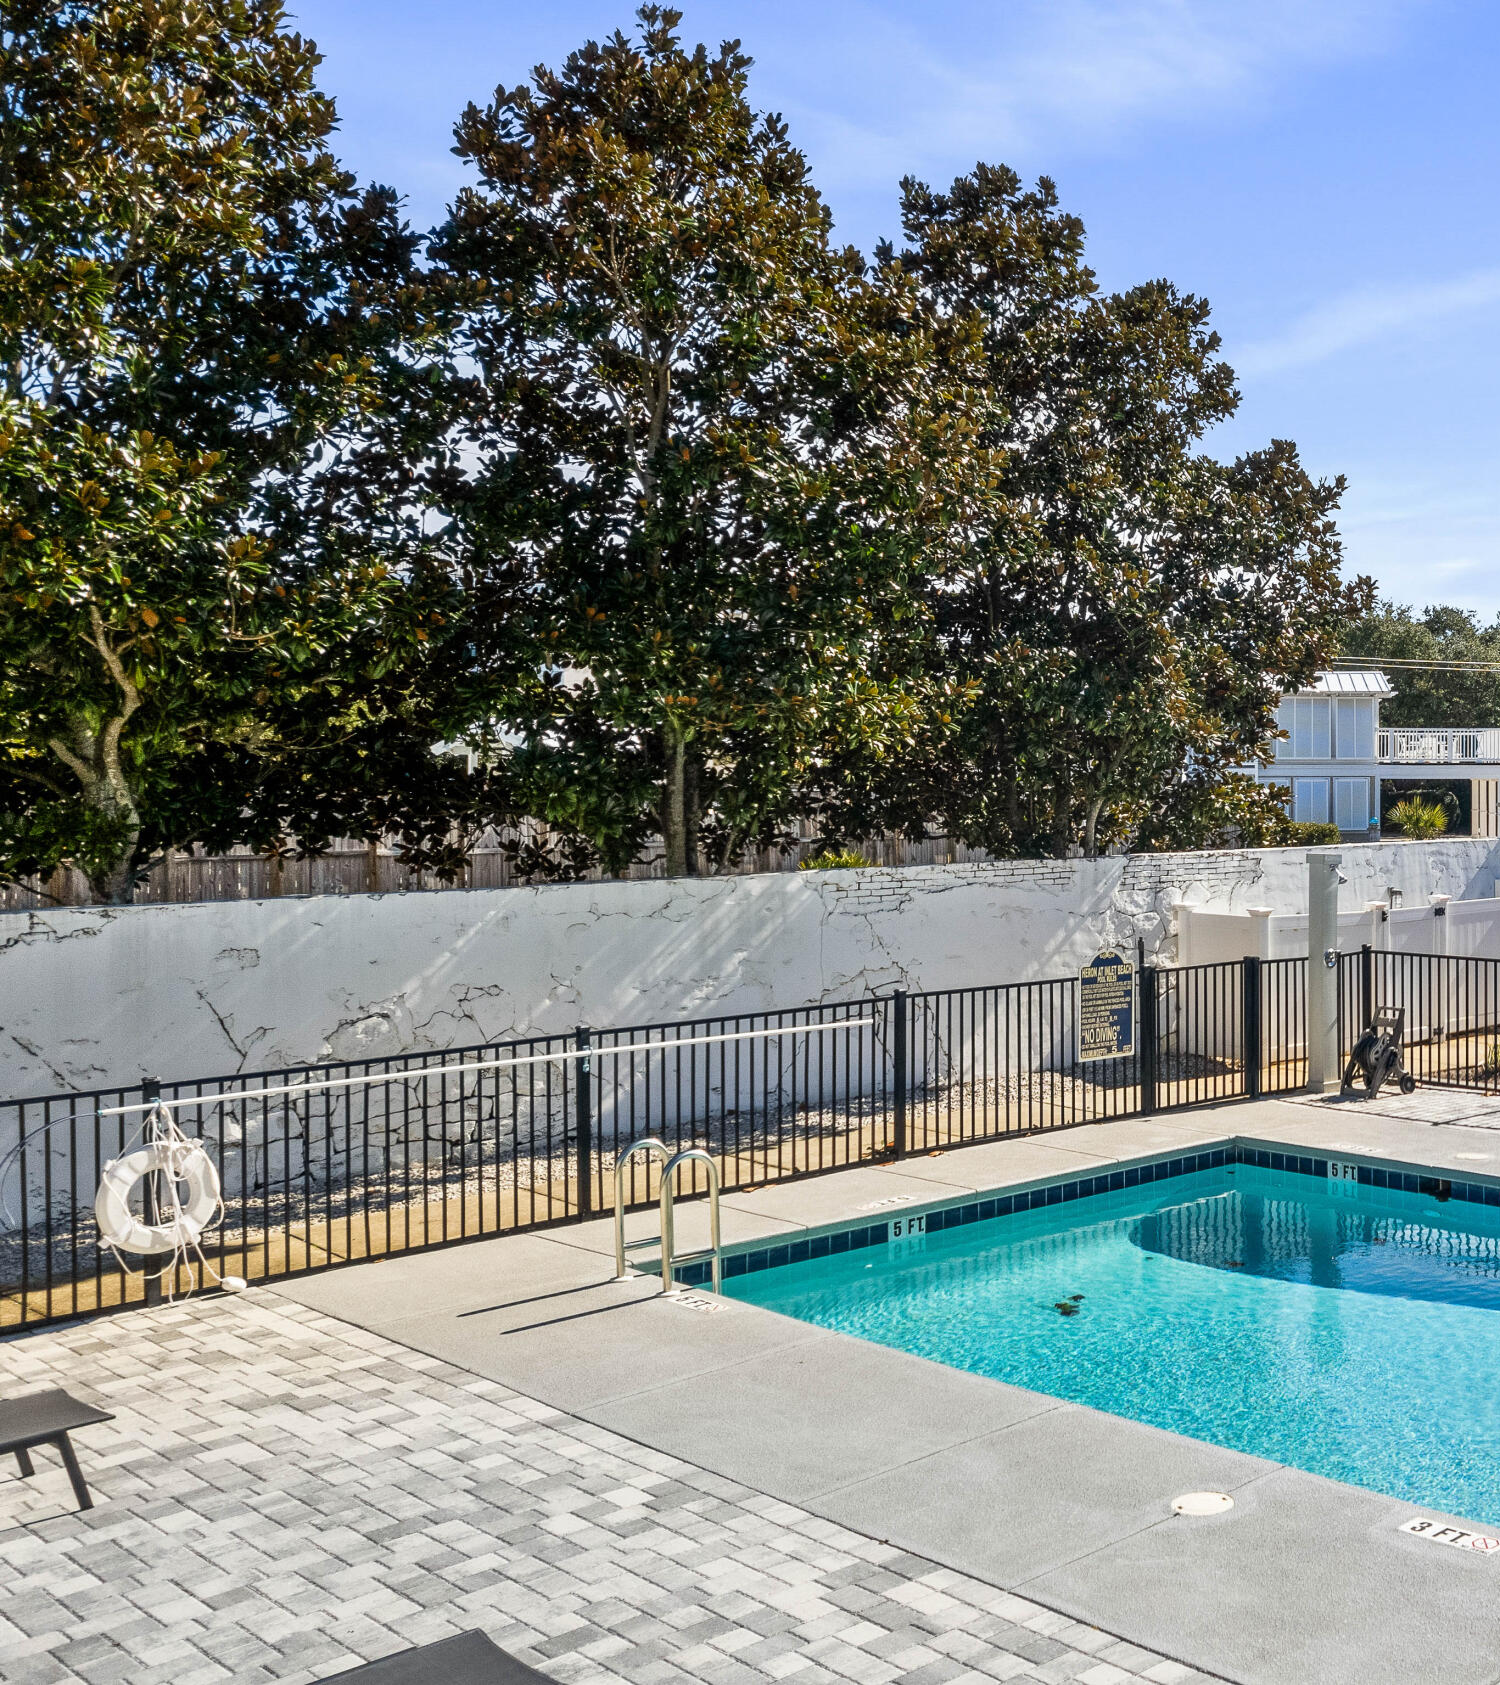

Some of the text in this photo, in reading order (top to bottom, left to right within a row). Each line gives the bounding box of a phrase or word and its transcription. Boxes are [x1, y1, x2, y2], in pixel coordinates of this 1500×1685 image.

[1082, 964, 1132, 978] HERON AT INLET BEACH
[1111, 1045, 1118, 1053] 5
[1331, 1162, 1339, 1177] 5
[893, 1220, 902, 1237] 5
[1410, 1521, 1433, 1533] 3
